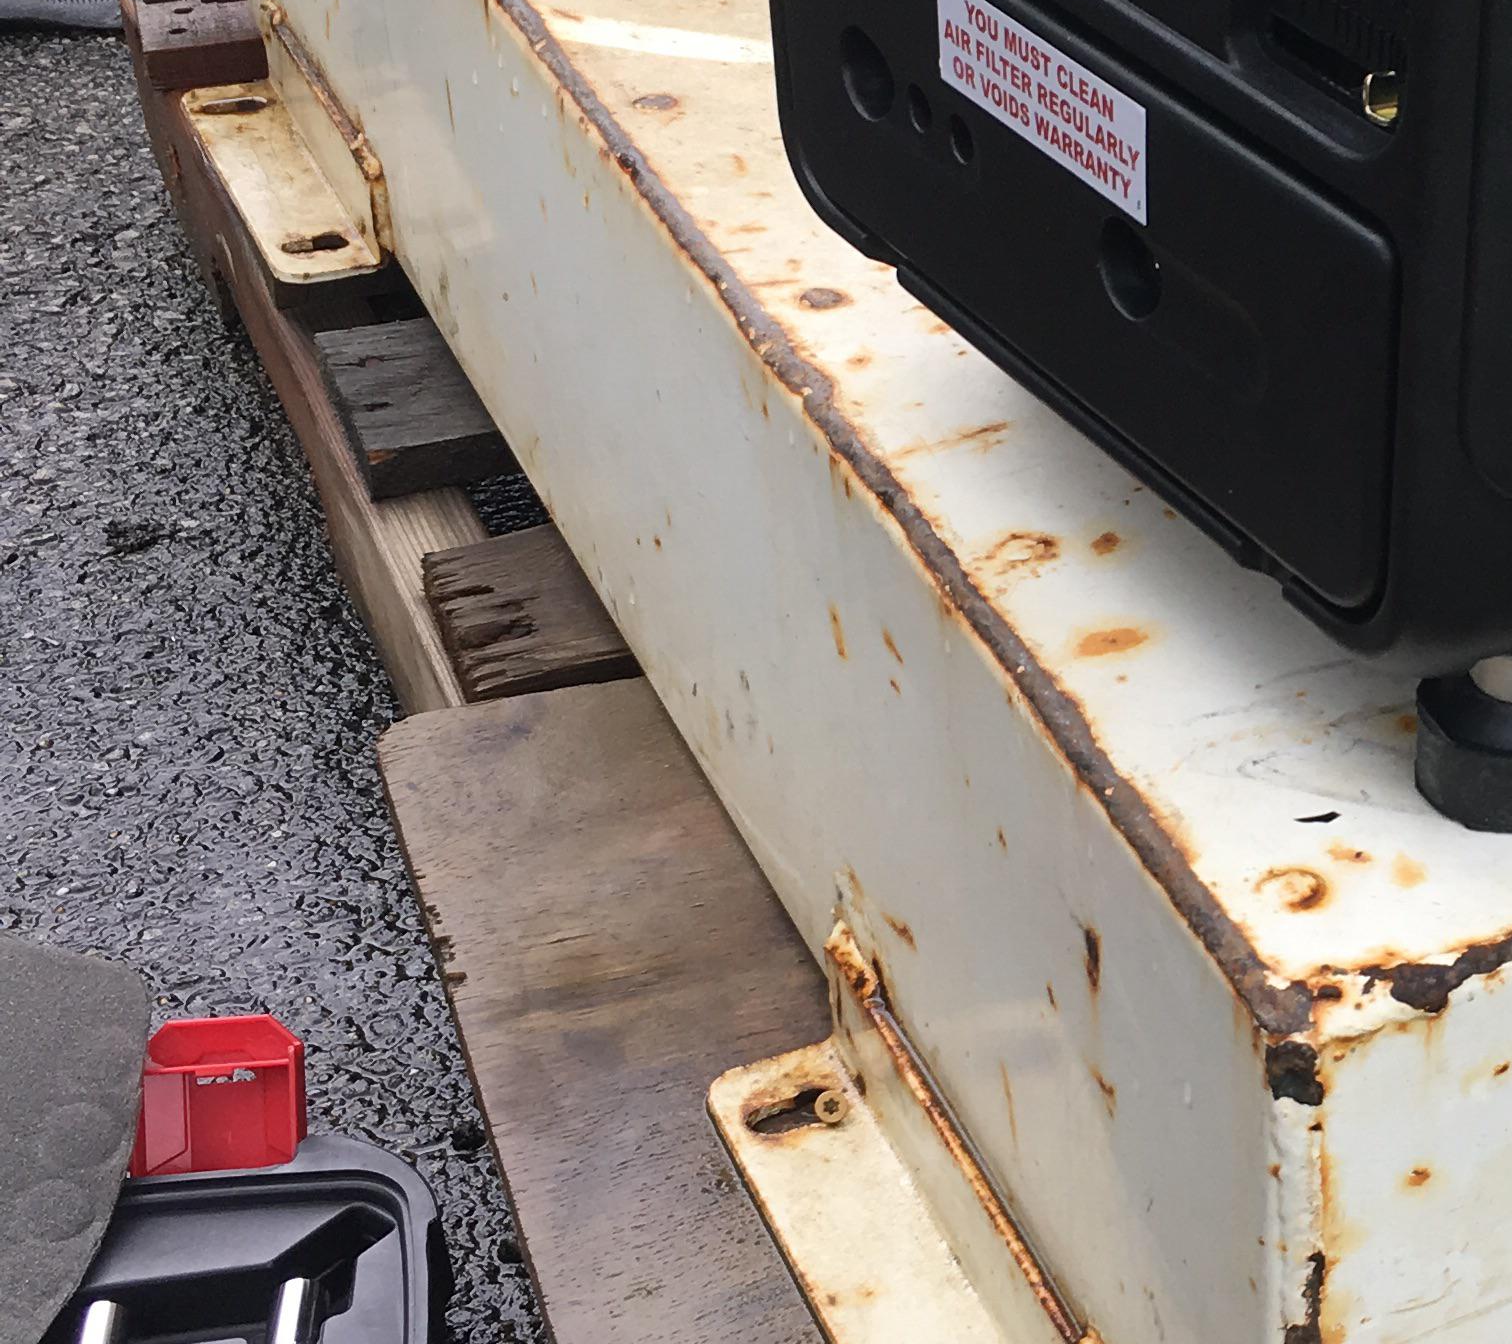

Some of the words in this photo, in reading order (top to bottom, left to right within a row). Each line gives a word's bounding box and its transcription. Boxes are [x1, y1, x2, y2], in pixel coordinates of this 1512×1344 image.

[944, 19, 971, 55] AIR
[975, 38, 1032, 99] FILTER
[1036, 82, 1139, 171] REGULARLY
[953, 55, 976, 89] OR
[979, 73, 1030, 127] VOIDS
[1034, 111, 1131, 199] WARRANTY
[963, 0, 998, 41] YOU
[1003, 26, 1051, 77] MUST
[1056, 64, 1113, 122] CLEAN
